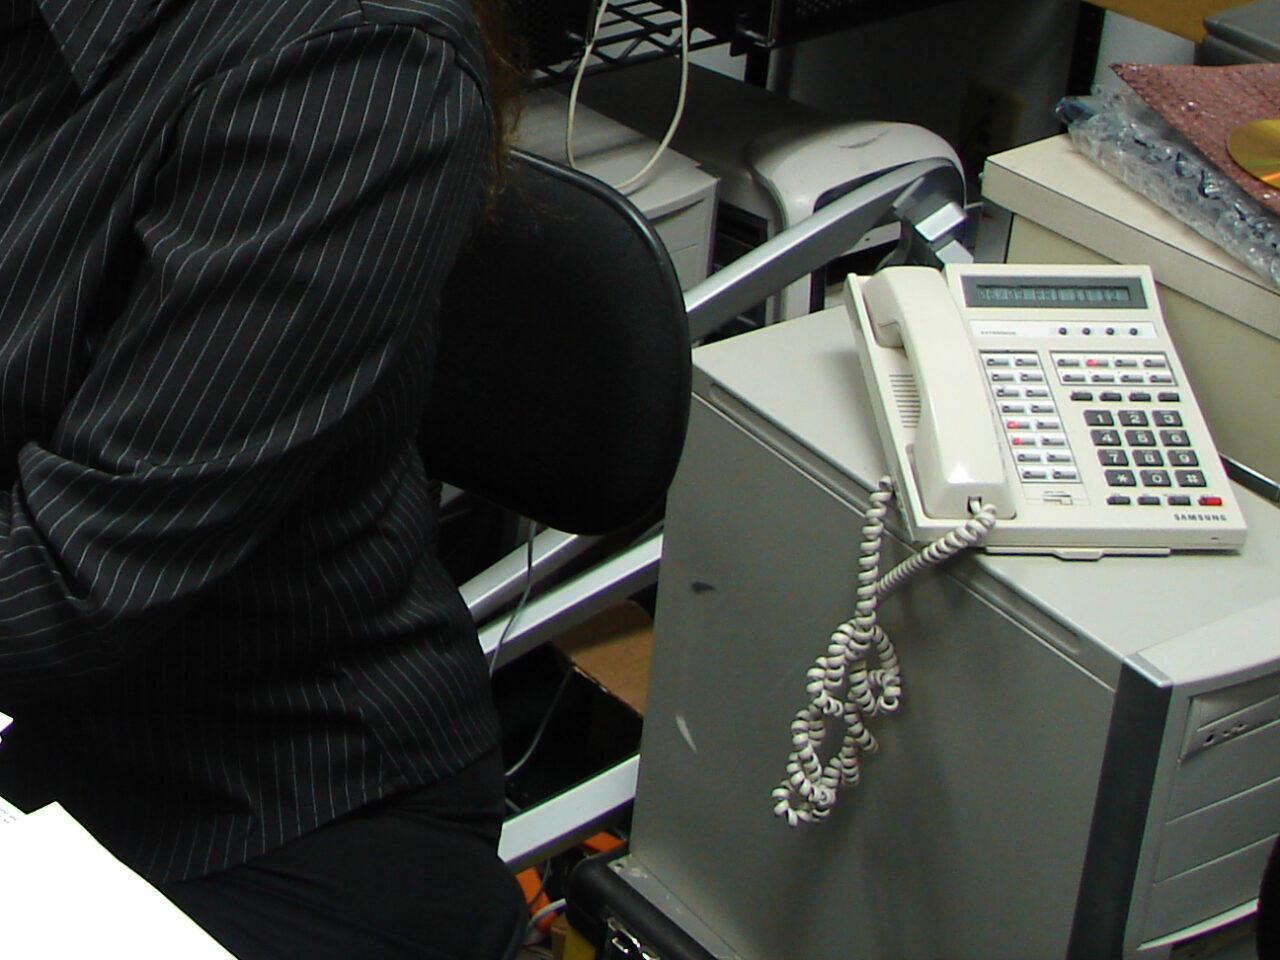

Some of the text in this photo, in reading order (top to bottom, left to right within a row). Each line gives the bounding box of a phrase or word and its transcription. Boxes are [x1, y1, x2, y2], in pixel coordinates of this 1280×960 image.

[1096, 414, 1174, 424] 1 2 3
[1102, 434, 1113, 442] 4
[1171, 434, 1182, 443] 6
[1108, 454, 1119, 463] 7
[1178, 454, 1190, 463] 9
[1174, 513, 1227, 521] SAMSUNG
